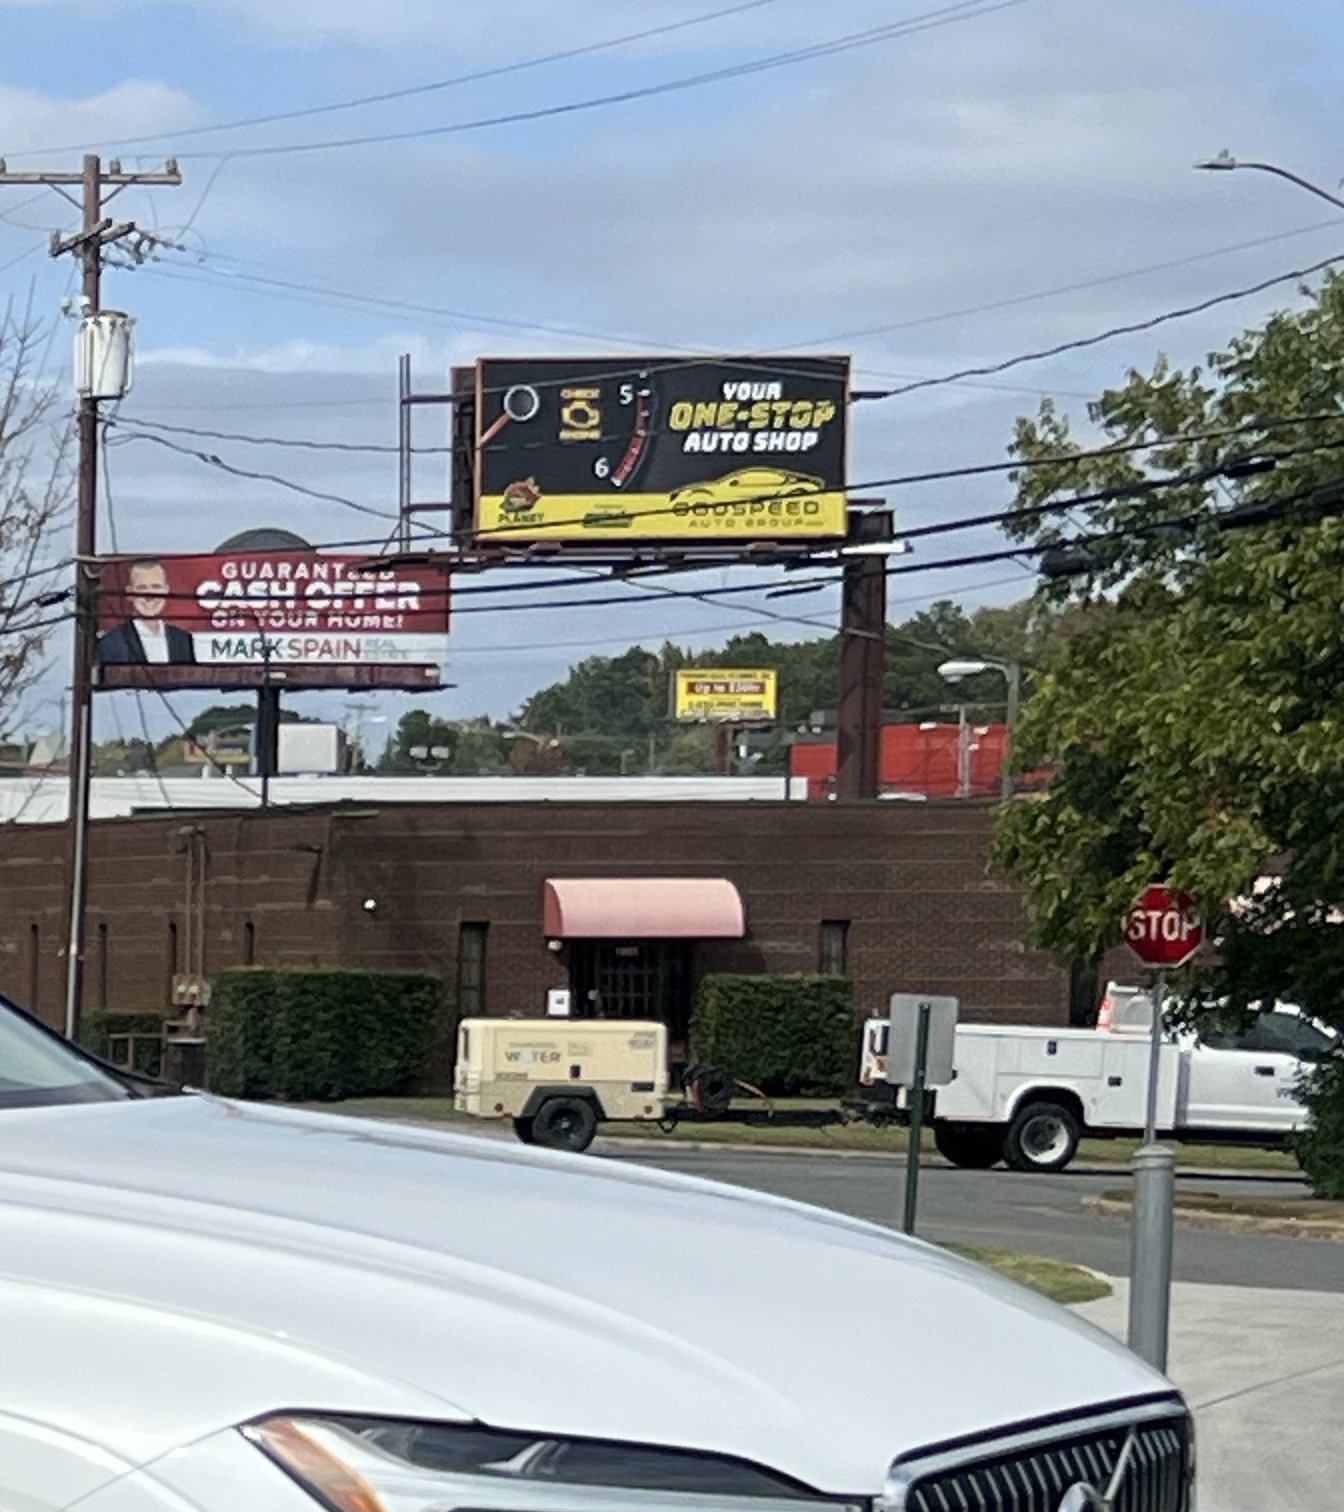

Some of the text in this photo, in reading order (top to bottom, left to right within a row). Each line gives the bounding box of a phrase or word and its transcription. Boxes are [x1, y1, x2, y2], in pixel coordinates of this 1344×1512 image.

[619, 384, 633, 405] 5
[723, 382, 782, 401] YOUR
[669, 401, 836, 431] ONE-STOP
[683, 432, 819, 453] AUTO SHOP
[595, 458, 609, 478] 6
[688, 518, 736, 528] AUTO
[196, 580, 421, 609] CASH OFFER
[212, 610, 244, 628] ON
[254, 610, 317, 628] YOUR
[212, 638, 361, 660] MARK SPAIN
[1128, 909, 1201, 942] STOP
[504, 1051, 561, 1064] WTER
